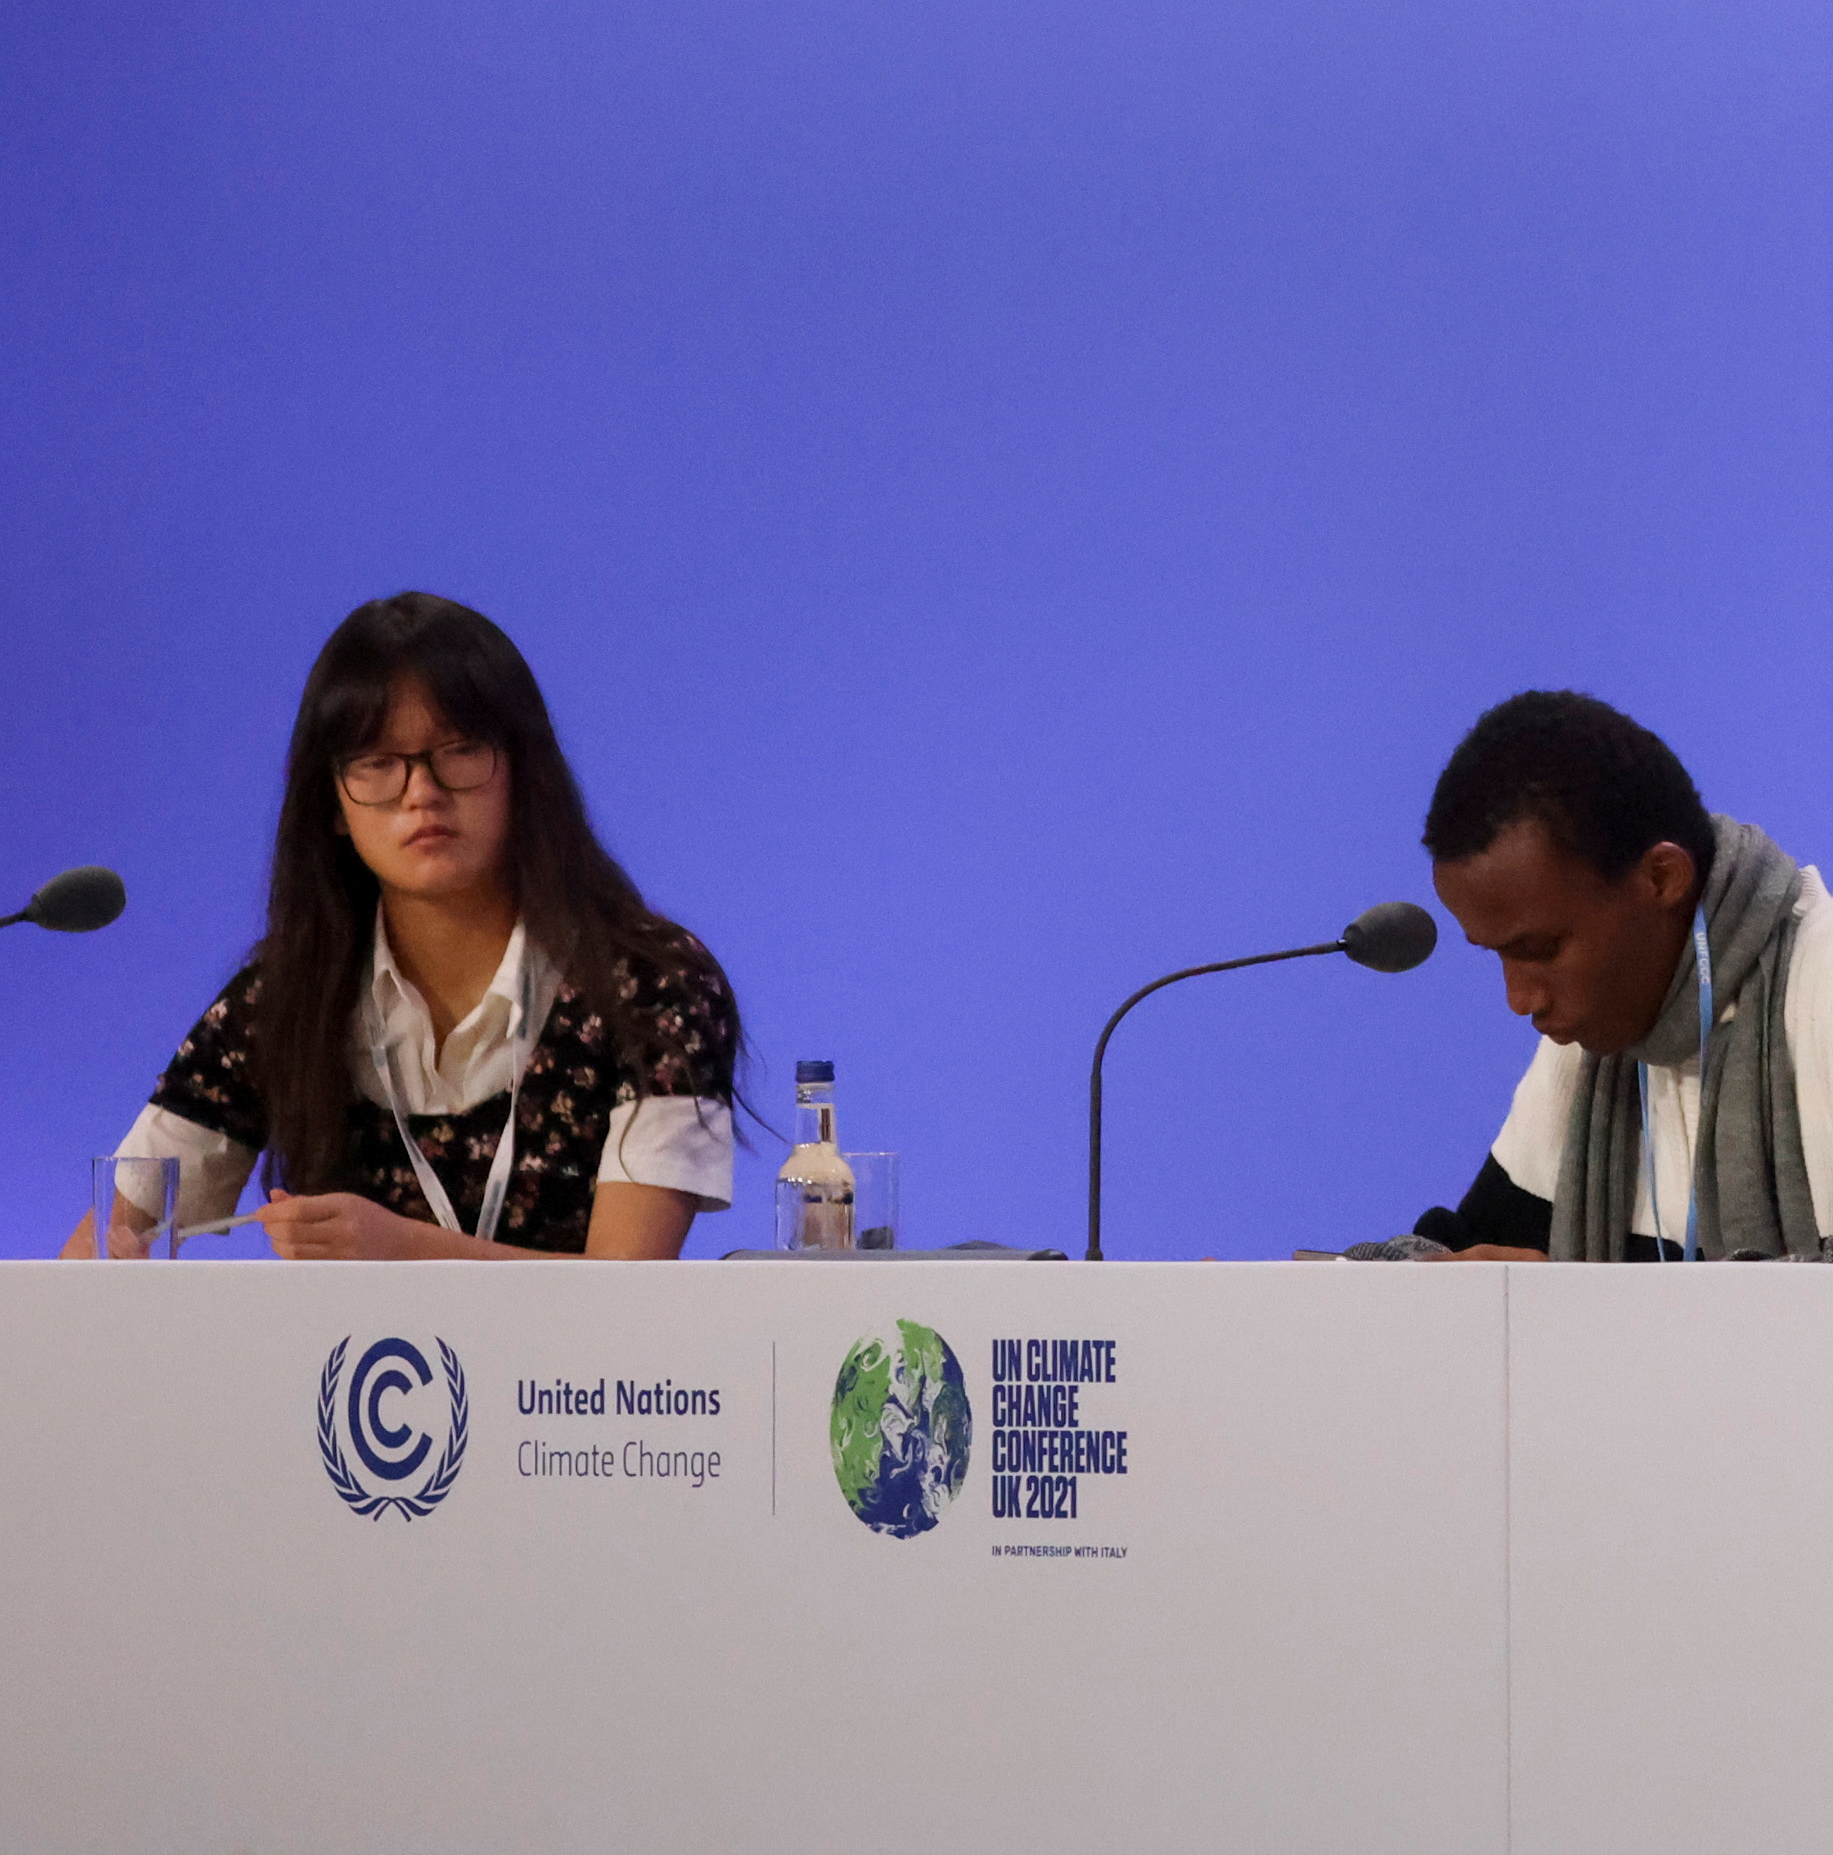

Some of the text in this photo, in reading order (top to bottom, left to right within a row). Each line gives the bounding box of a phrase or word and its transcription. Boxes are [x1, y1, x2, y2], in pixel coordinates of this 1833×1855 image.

[992, 1339, 1116, 1383] UN CLIMATE
[517, 1378, 721, 1416] United Nations
[992, 1384, 1079, 1429] CHANGE
[517, 1439, 721, 1489] Climate Change
[992, 1429, 1128, 1475] CONFERENCE
[992, 1474, 1077, 1519] UK 2021
[992, 1545, 1128, 1558] IN PARTNERSHIP WITH ITALY
